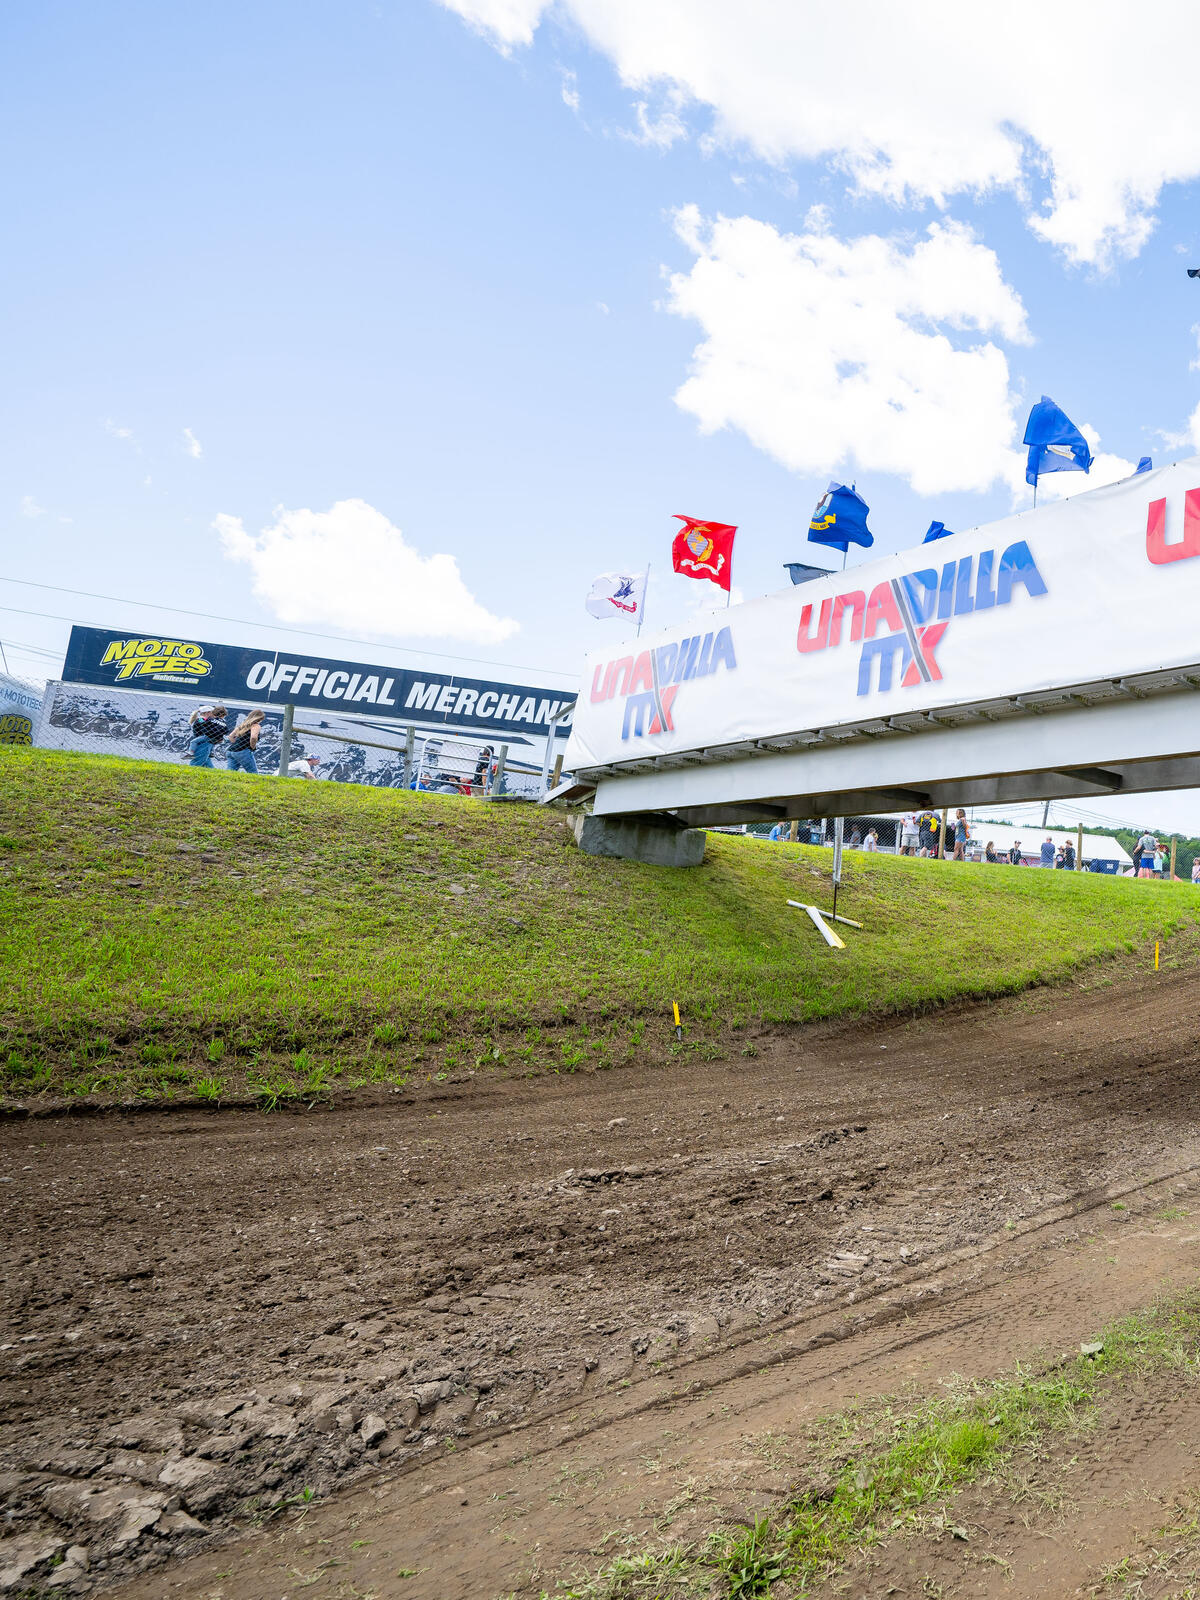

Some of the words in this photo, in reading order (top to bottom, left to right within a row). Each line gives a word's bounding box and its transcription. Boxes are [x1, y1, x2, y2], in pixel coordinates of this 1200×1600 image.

[101, 639, 203, 665] MOTO
[115, 656, 212, 681] TEES
[246, 660, 396, 706] OFFICIAL
